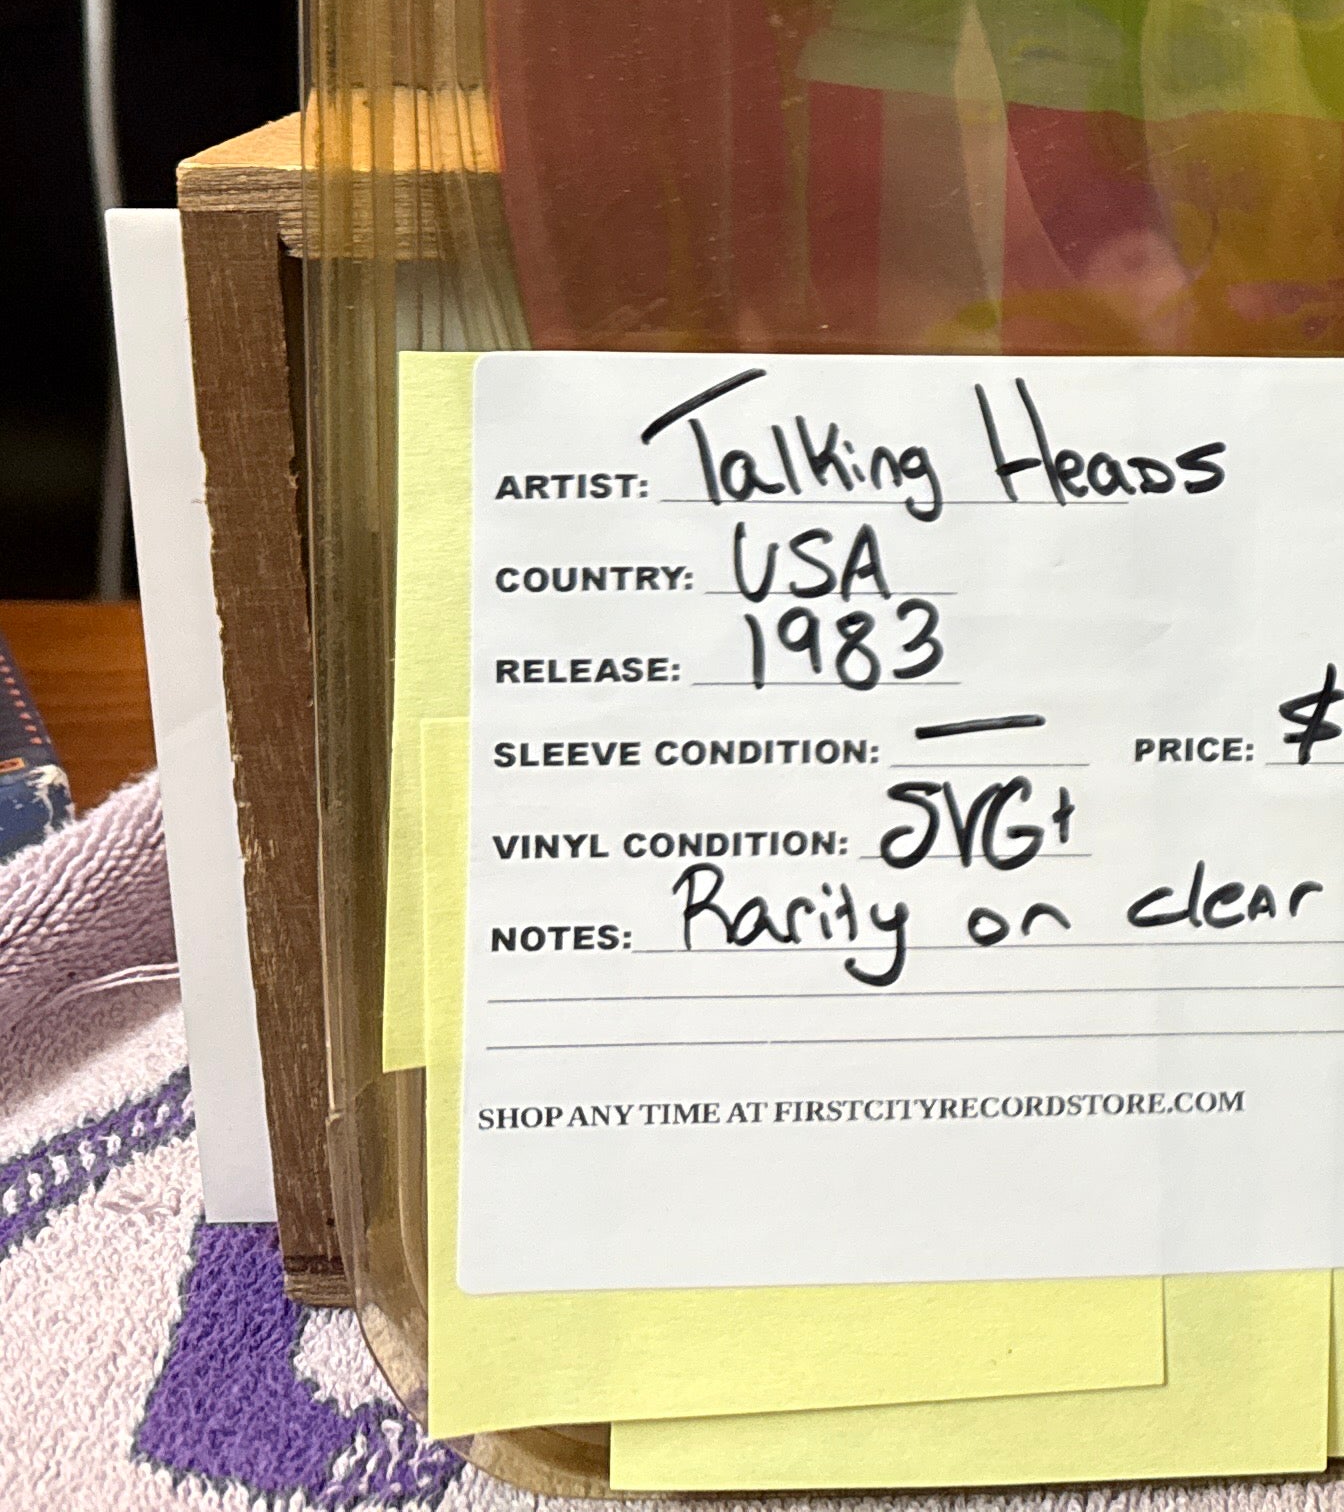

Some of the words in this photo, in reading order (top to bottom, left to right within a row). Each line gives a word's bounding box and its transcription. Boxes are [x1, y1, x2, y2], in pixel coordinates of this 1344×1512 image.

[641, 367, 943, 522] Talking
[495, 474, 649, 500] ARTIST:
[733, 521, 891, 602] USA
[494, 567, 694, 594] COUNTRY:
[744, 598, 944, 691] 1983
[495, 656, 680, 683] RELEASE:
[494, 742, 641, 767] SLEEVE
[654, 739, 879, 766] CONDITION:
[1134, 737, 1254, 763] PRICE:
[493, 834, 610, 859] VINYL
[623, 831, 848, 858] CONDITION:
[491, 925, 632, 952] NOTES:
[672, 862, 908, 987] Rarity
[968, 902, 1071, 946] on
[477, 1106, 562, 1130] SHOP
[566, 1105, 635, 1128] ANY
[639, 1102, 720, 1126] TIME
[726, 1101, 769, 1124] AT
[773, 1090, 1246, 1123] FIRSTCITYRECORDSTORE.COM
